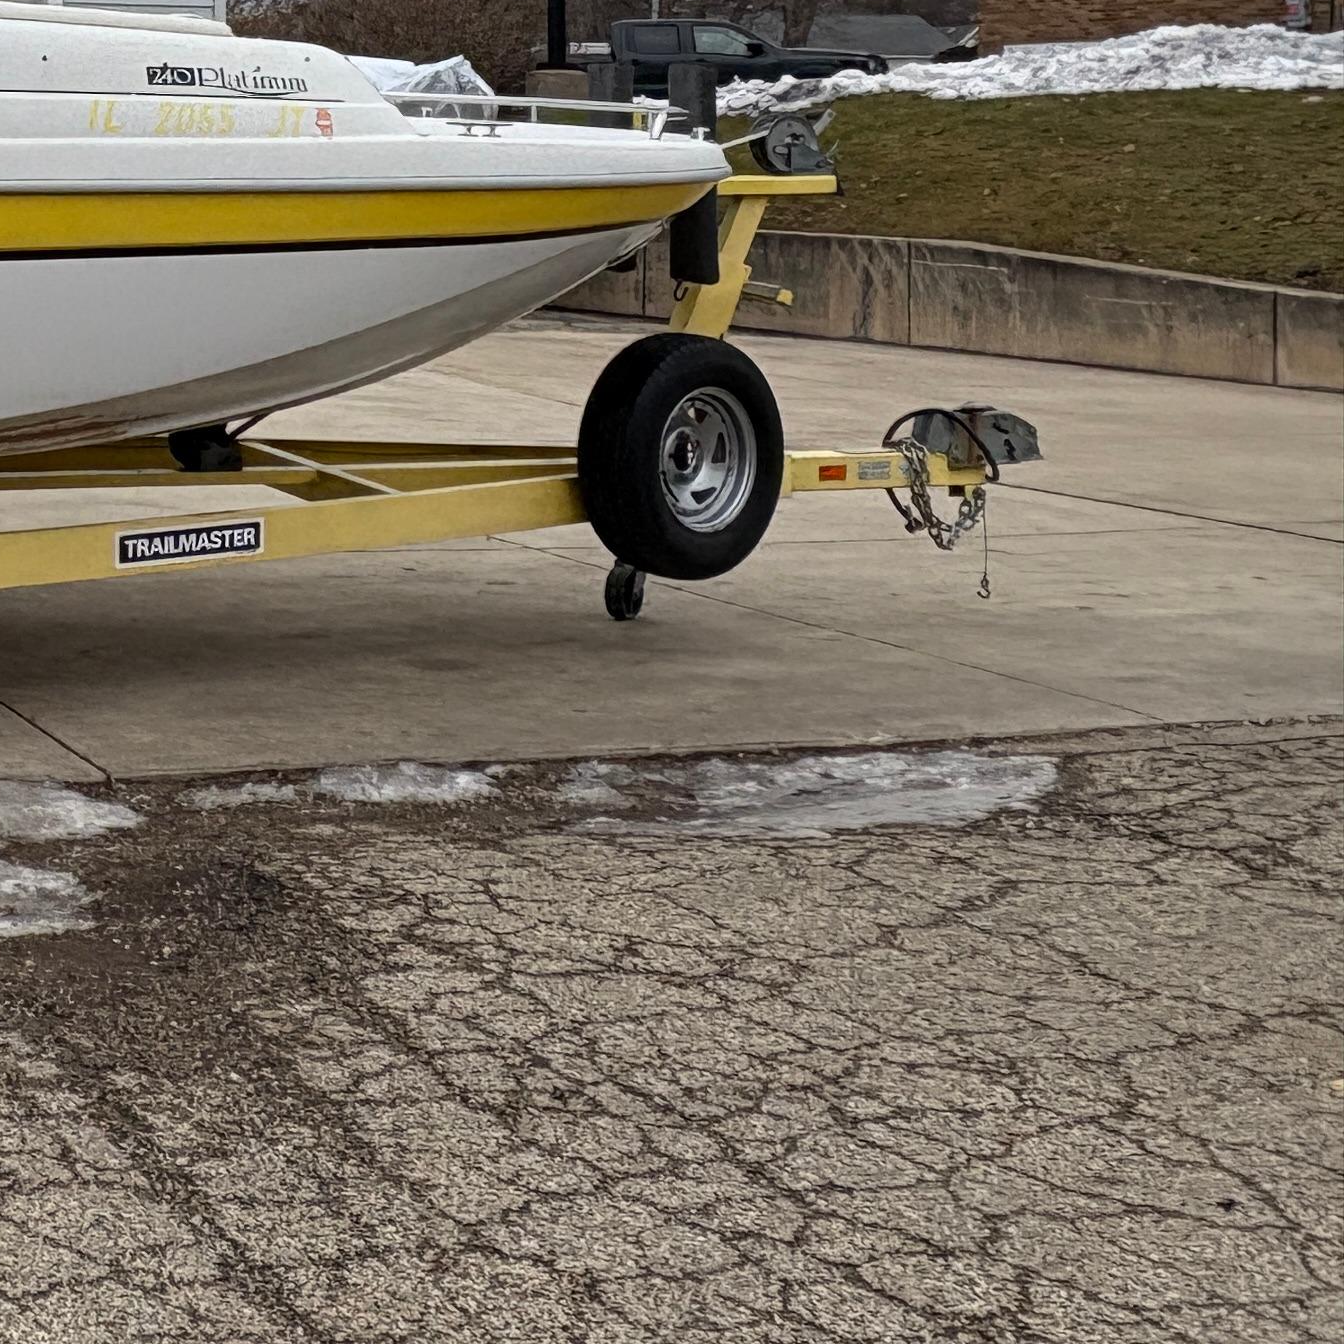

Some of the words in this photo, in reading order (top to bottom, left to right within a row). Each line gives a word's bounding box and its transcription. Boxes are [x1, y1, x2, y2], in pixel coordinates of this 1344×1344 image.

[148, 64, 194, 85] 240
[198, 65, 308, 93] Platinum
[124, 527, 256, 559] TRAILMASTER
